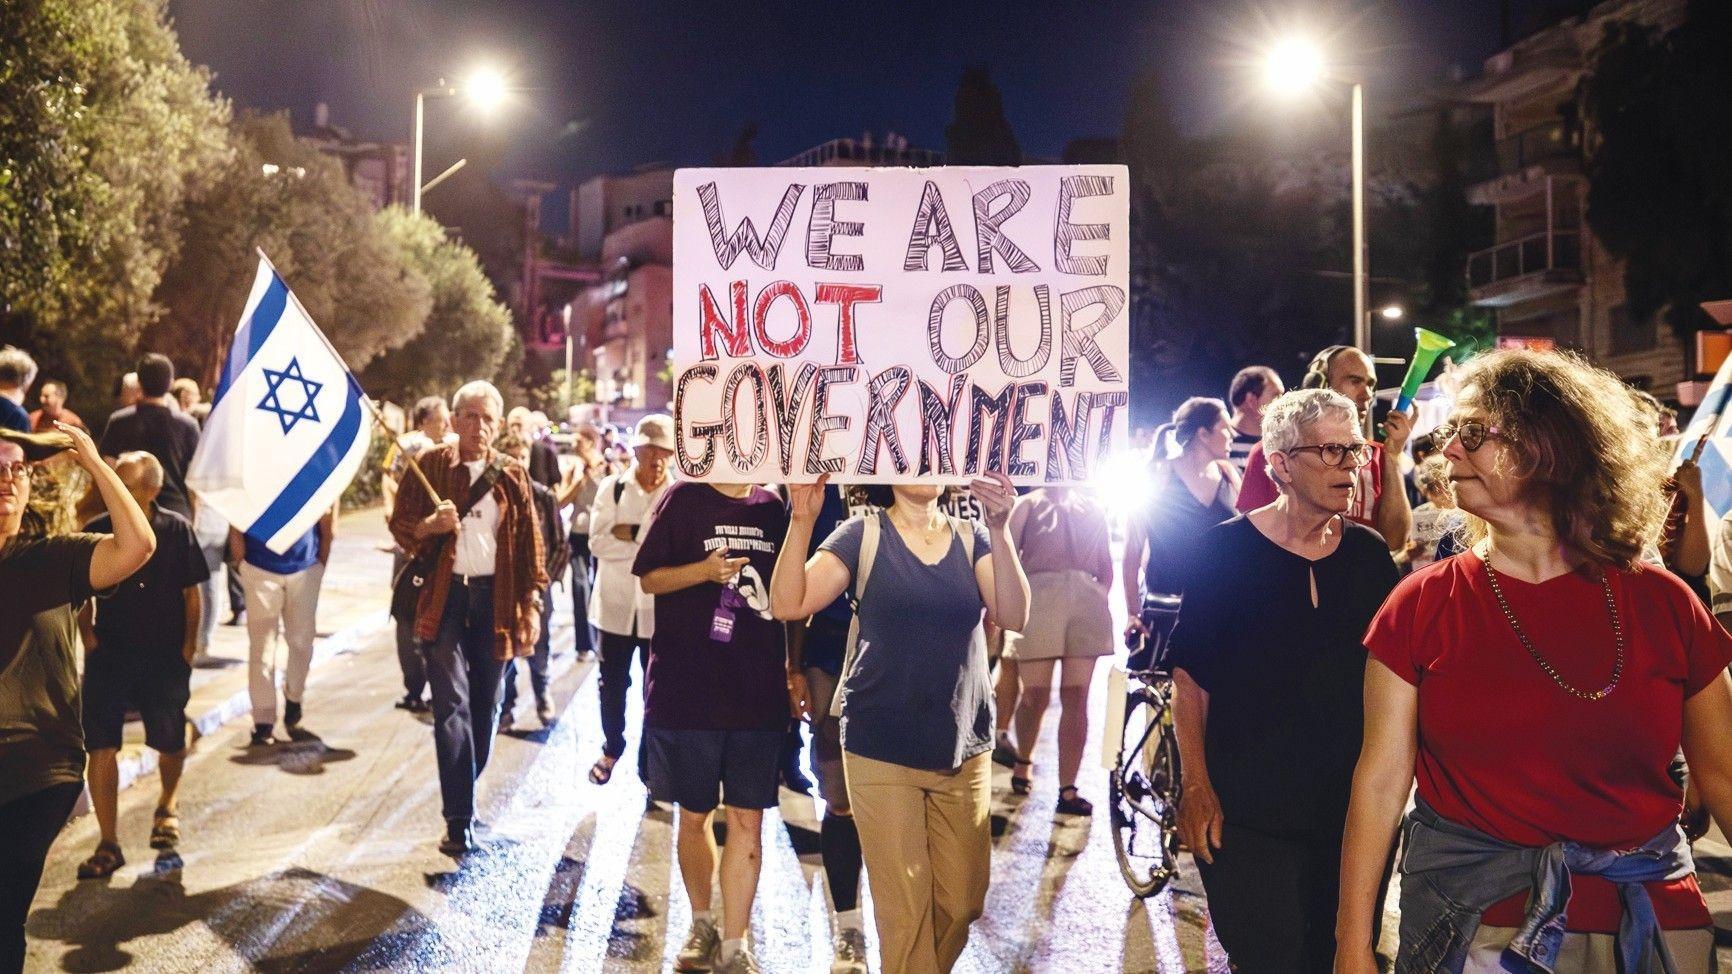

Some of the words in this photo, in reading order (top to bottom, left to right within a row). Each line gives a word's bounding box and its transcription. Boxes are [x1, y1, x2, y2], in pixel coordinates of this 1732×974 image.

[695, 180, 870, 271] WE
[903, 176, 1115, 276] ARE
[699, 279, 883, 365] NOT
[927, 283, 1127, 388] OUR
[674, 362, 1128, 482] GOVERNMENT
